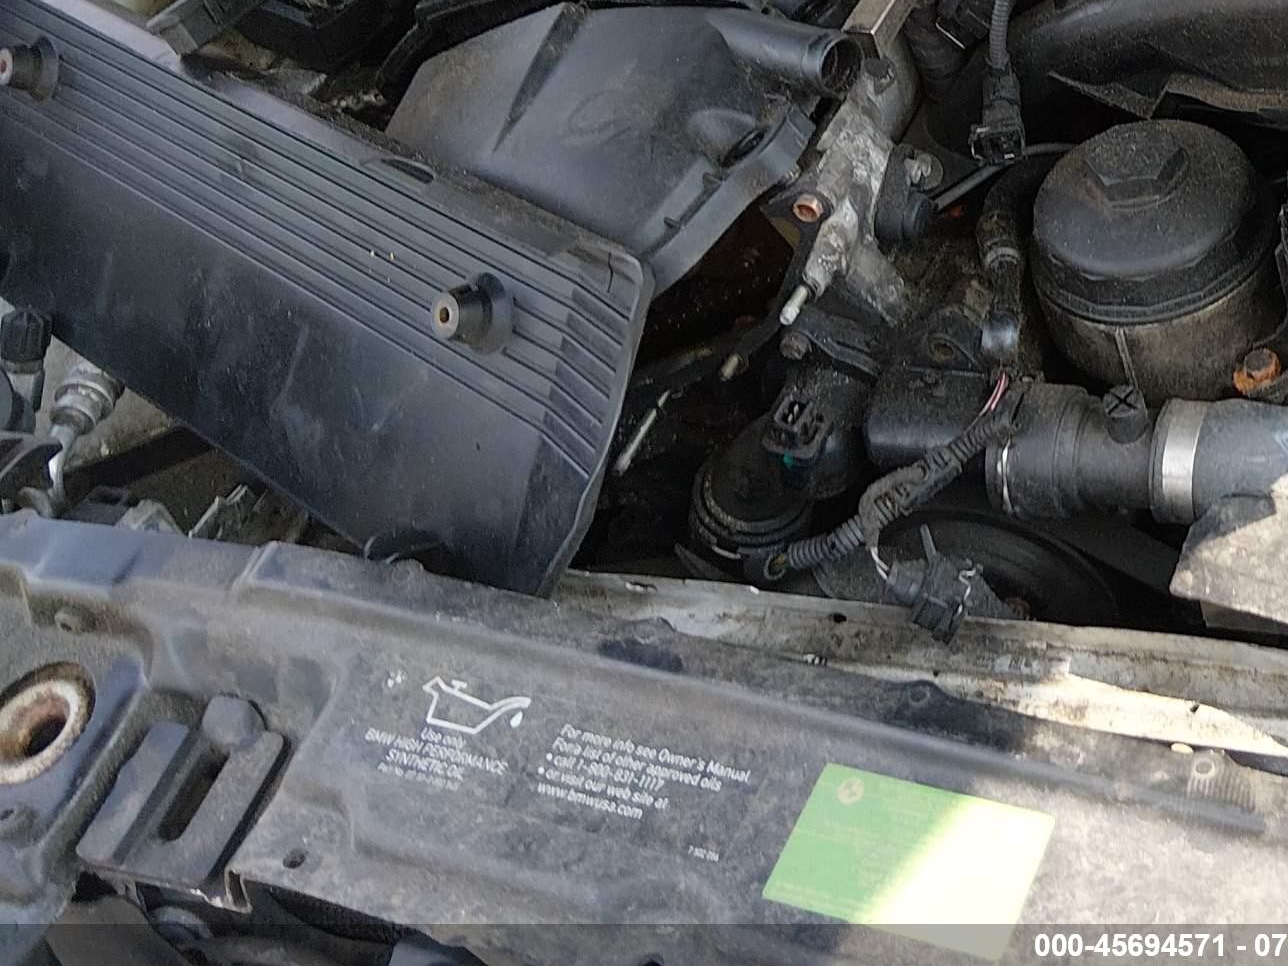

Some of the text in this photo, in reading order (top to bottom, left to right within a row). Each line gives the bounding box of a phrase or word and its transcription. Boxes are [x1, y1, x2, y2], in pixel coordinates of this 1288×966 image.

[385, 749, 449, 776] SYNTHETIC
[422, 744, 508, 775] PERFORMANCE
[560, 723, 751, 784] For more info see Owner's Manual
[582, 744, 602, 761] list
[602, 751, 617, 764] of
[615, 754, 646, 772] other
[646, 763, 701, 787] approved
[700, 775, 722, 792] oils
[545, 769, 670, 810] or visit our web site at
[553, 755, 665, 792] call 1-800-831-1117
[537, 782, 643, 820] www.bmwusa.com
